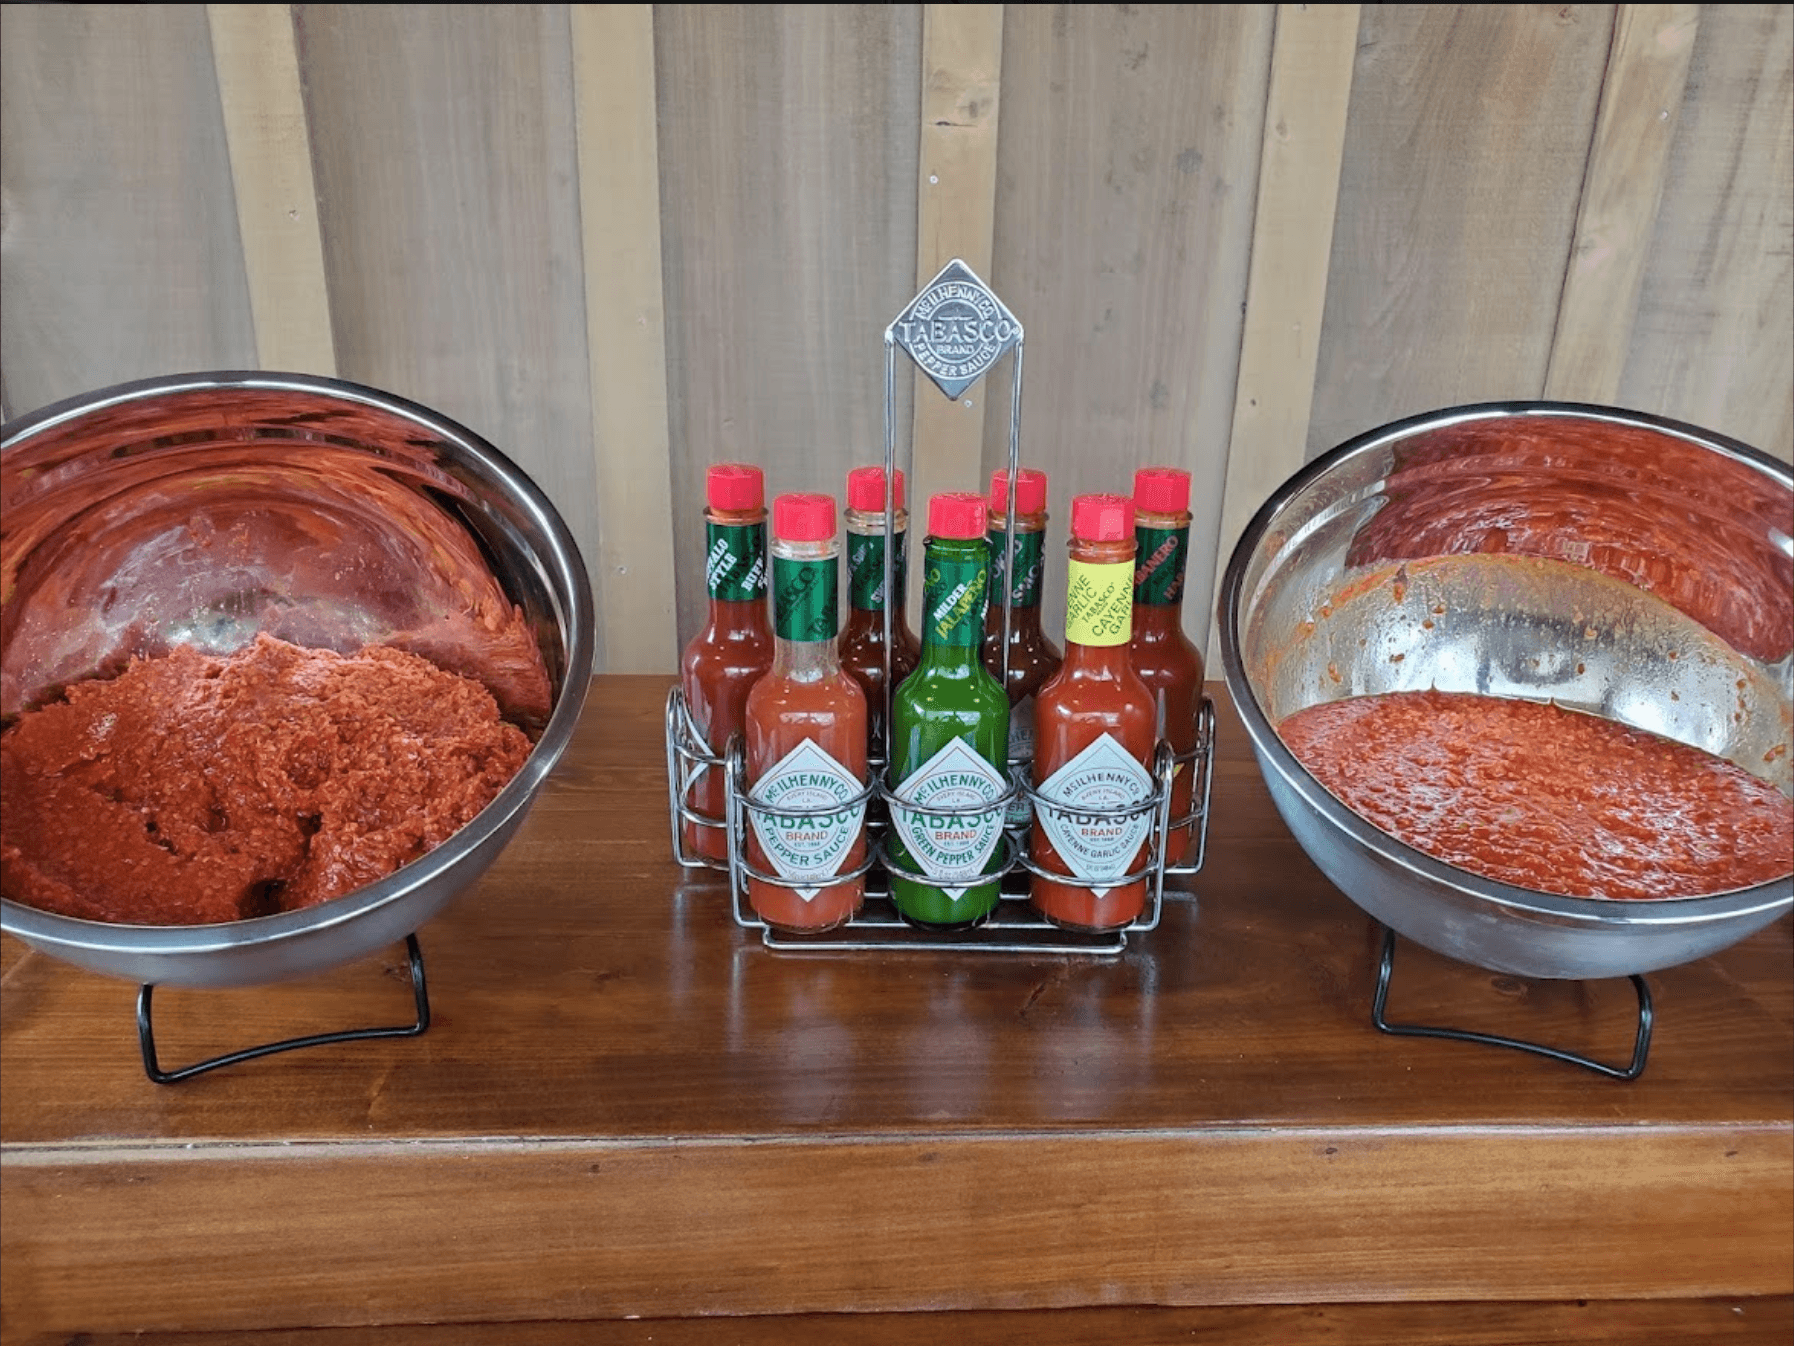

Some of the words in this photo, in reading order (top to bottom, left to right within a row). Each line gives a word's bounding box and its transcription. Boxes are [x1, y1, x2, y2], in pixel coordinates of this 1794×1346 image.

[914, 343, 957, 376] PEPPER
[960, 344, 996, 375] SAUCE
[936, 343, 974, 355] BRAND
[708, 552, 738, 591] STYLE
[933, 583, 967, 622] MILDER
[765, 827, 809, 866] PEPPER
[813, 825, 848, 864] SAUCE
[785, 831, 828, 841] BRAND
[912, 827, 936, 857] GREEN
[936, 850, 974, 865] PEPPER
[974, 823, 994, 854] SAUCE
[935, 829, 977, 840] BRAND
[1060, 823, 1089, 855] CAYENNE
[1090, 845, 1121, 858] GARLIC
[1121, 823, 1140, 849] SAUCE
[1081, 828, 1122, 836] BRAND
